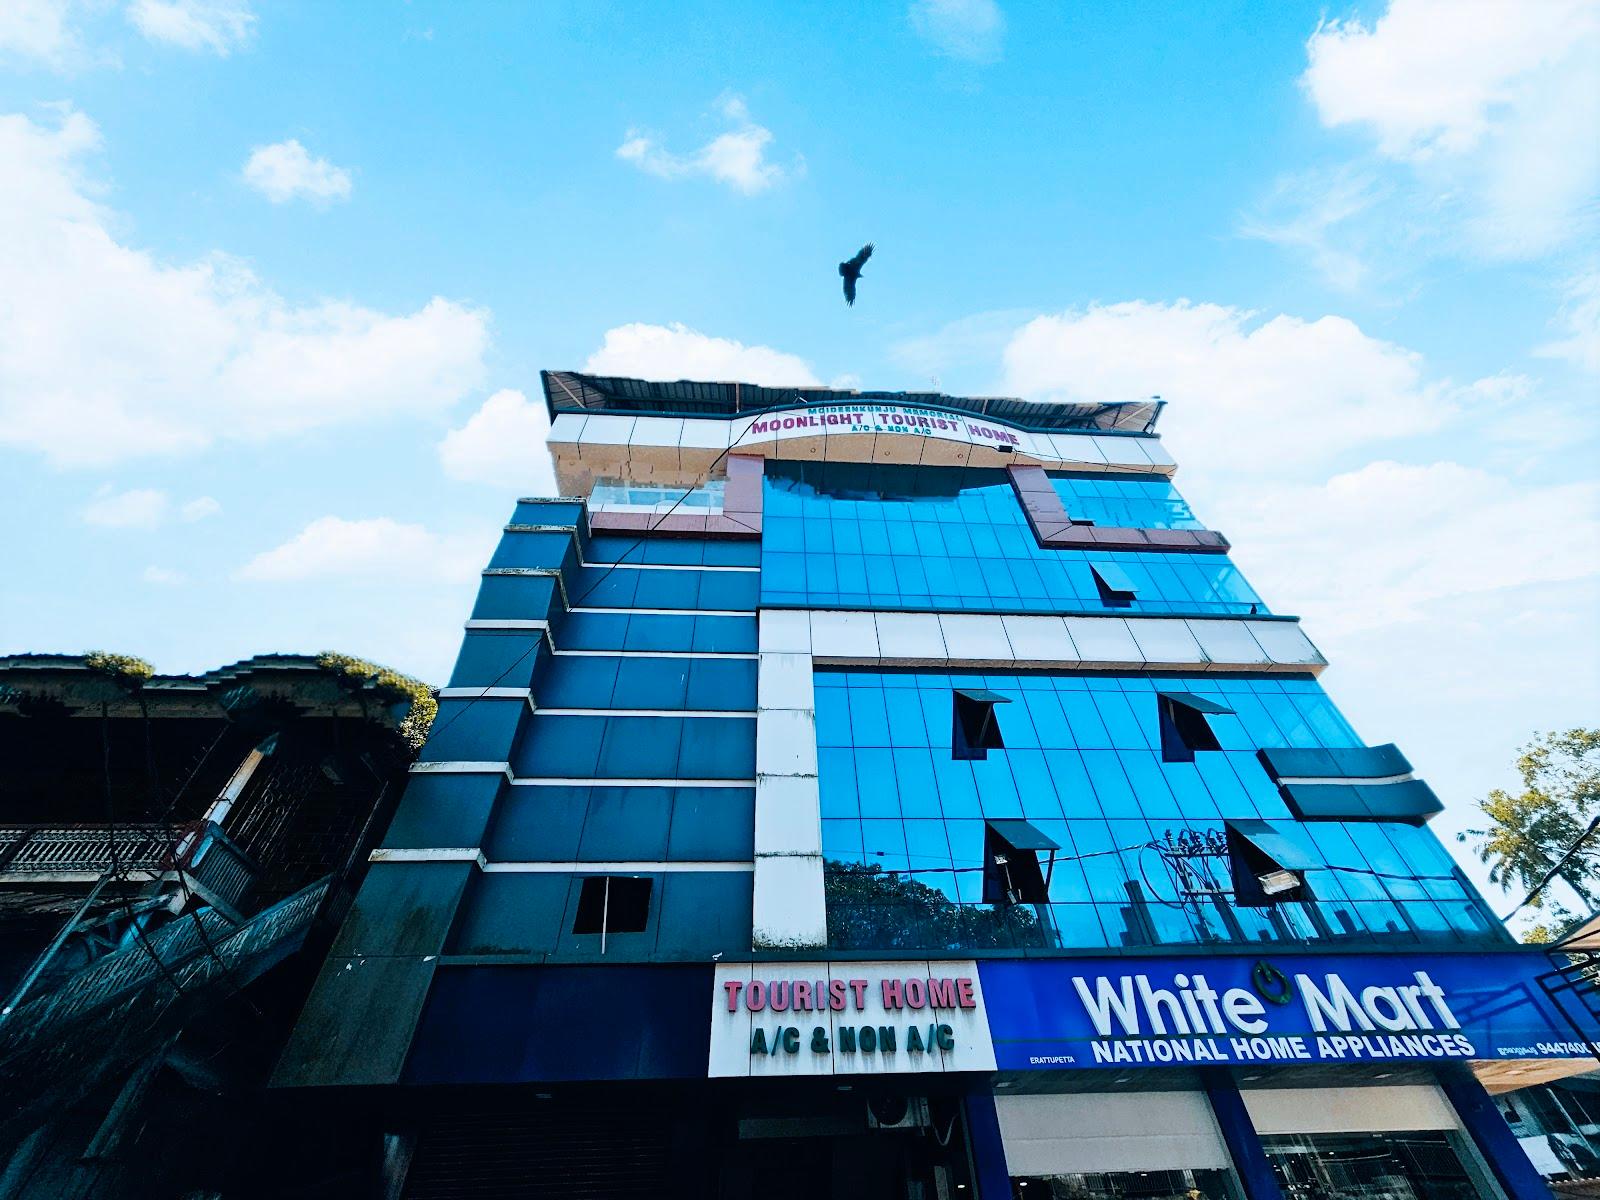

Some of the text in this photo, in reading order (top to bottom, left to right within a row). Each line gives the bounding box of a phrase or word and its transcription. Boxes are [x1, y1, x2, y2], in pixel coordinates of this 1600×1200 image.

[752, 413, 1020, 446] MOONLIGHT TOURIST HOME
[903, 408, 960, 420] MEMORIAL
[914, 427, 932, 435] A/C
[724, 978, 977, 1012] TOURIST HOME
[1072, 970, 1462, 1036] White Mart
[751, 1024, 955, 1056] A/C & NON A/C
[1090, 1034, 1476, 1064] NATIONAL HOME APPLIANCES
[1030, 1056, 1076, 1064] ERATTUPETTA
